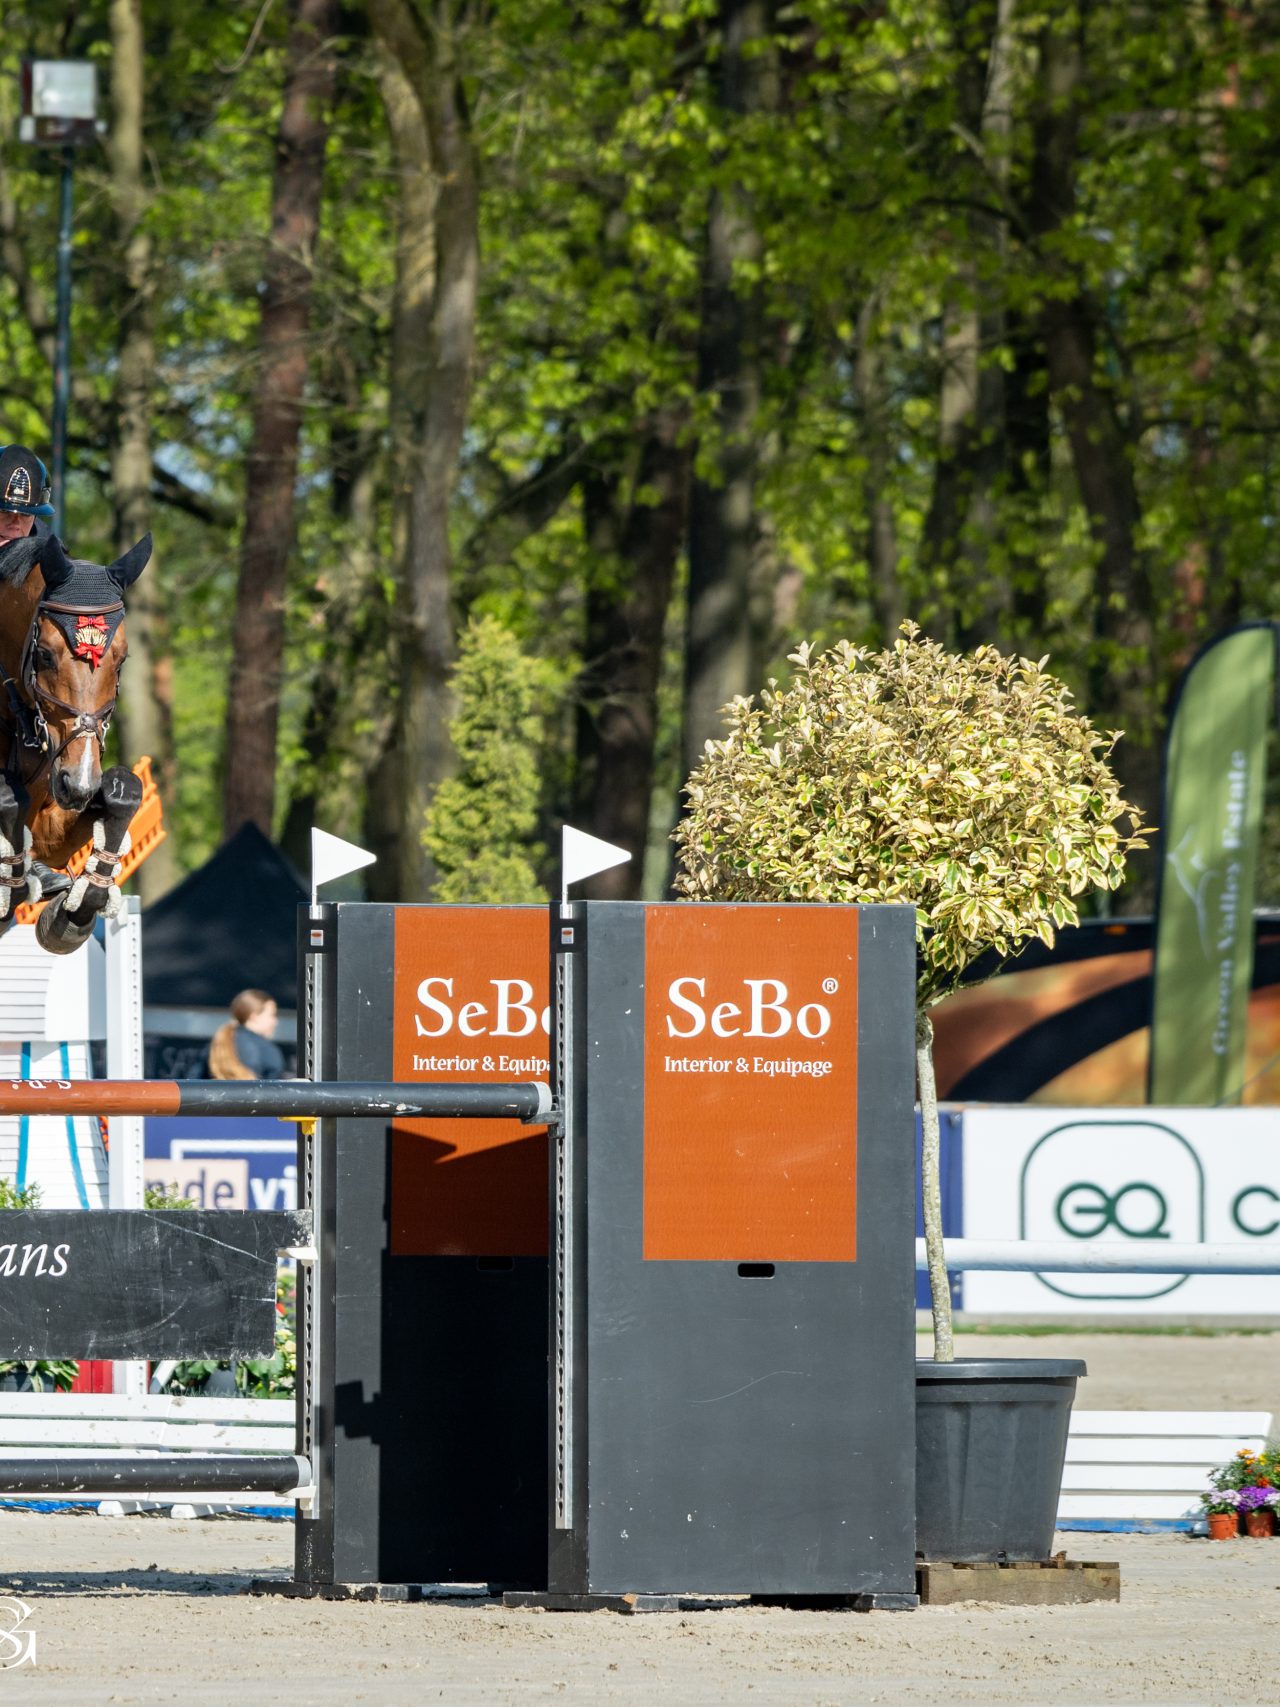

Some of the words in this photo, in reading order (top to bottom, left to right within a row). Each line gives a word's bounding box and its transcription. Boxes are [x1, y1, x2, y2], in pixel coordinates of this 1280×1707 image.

[1221, 750, 1247, 849] Estate
[1216, 860, 1243, 951] Valley
[414, 977, 551, 1037] SeB
[412, 1054, 480, 1072] Interior
[482, 1055, 495, 1071] &
[664, 1055, 733, 1073] Interior
[735, 1056, 749, 1073] &
[753, 1056, 832, 1078] Equipage
